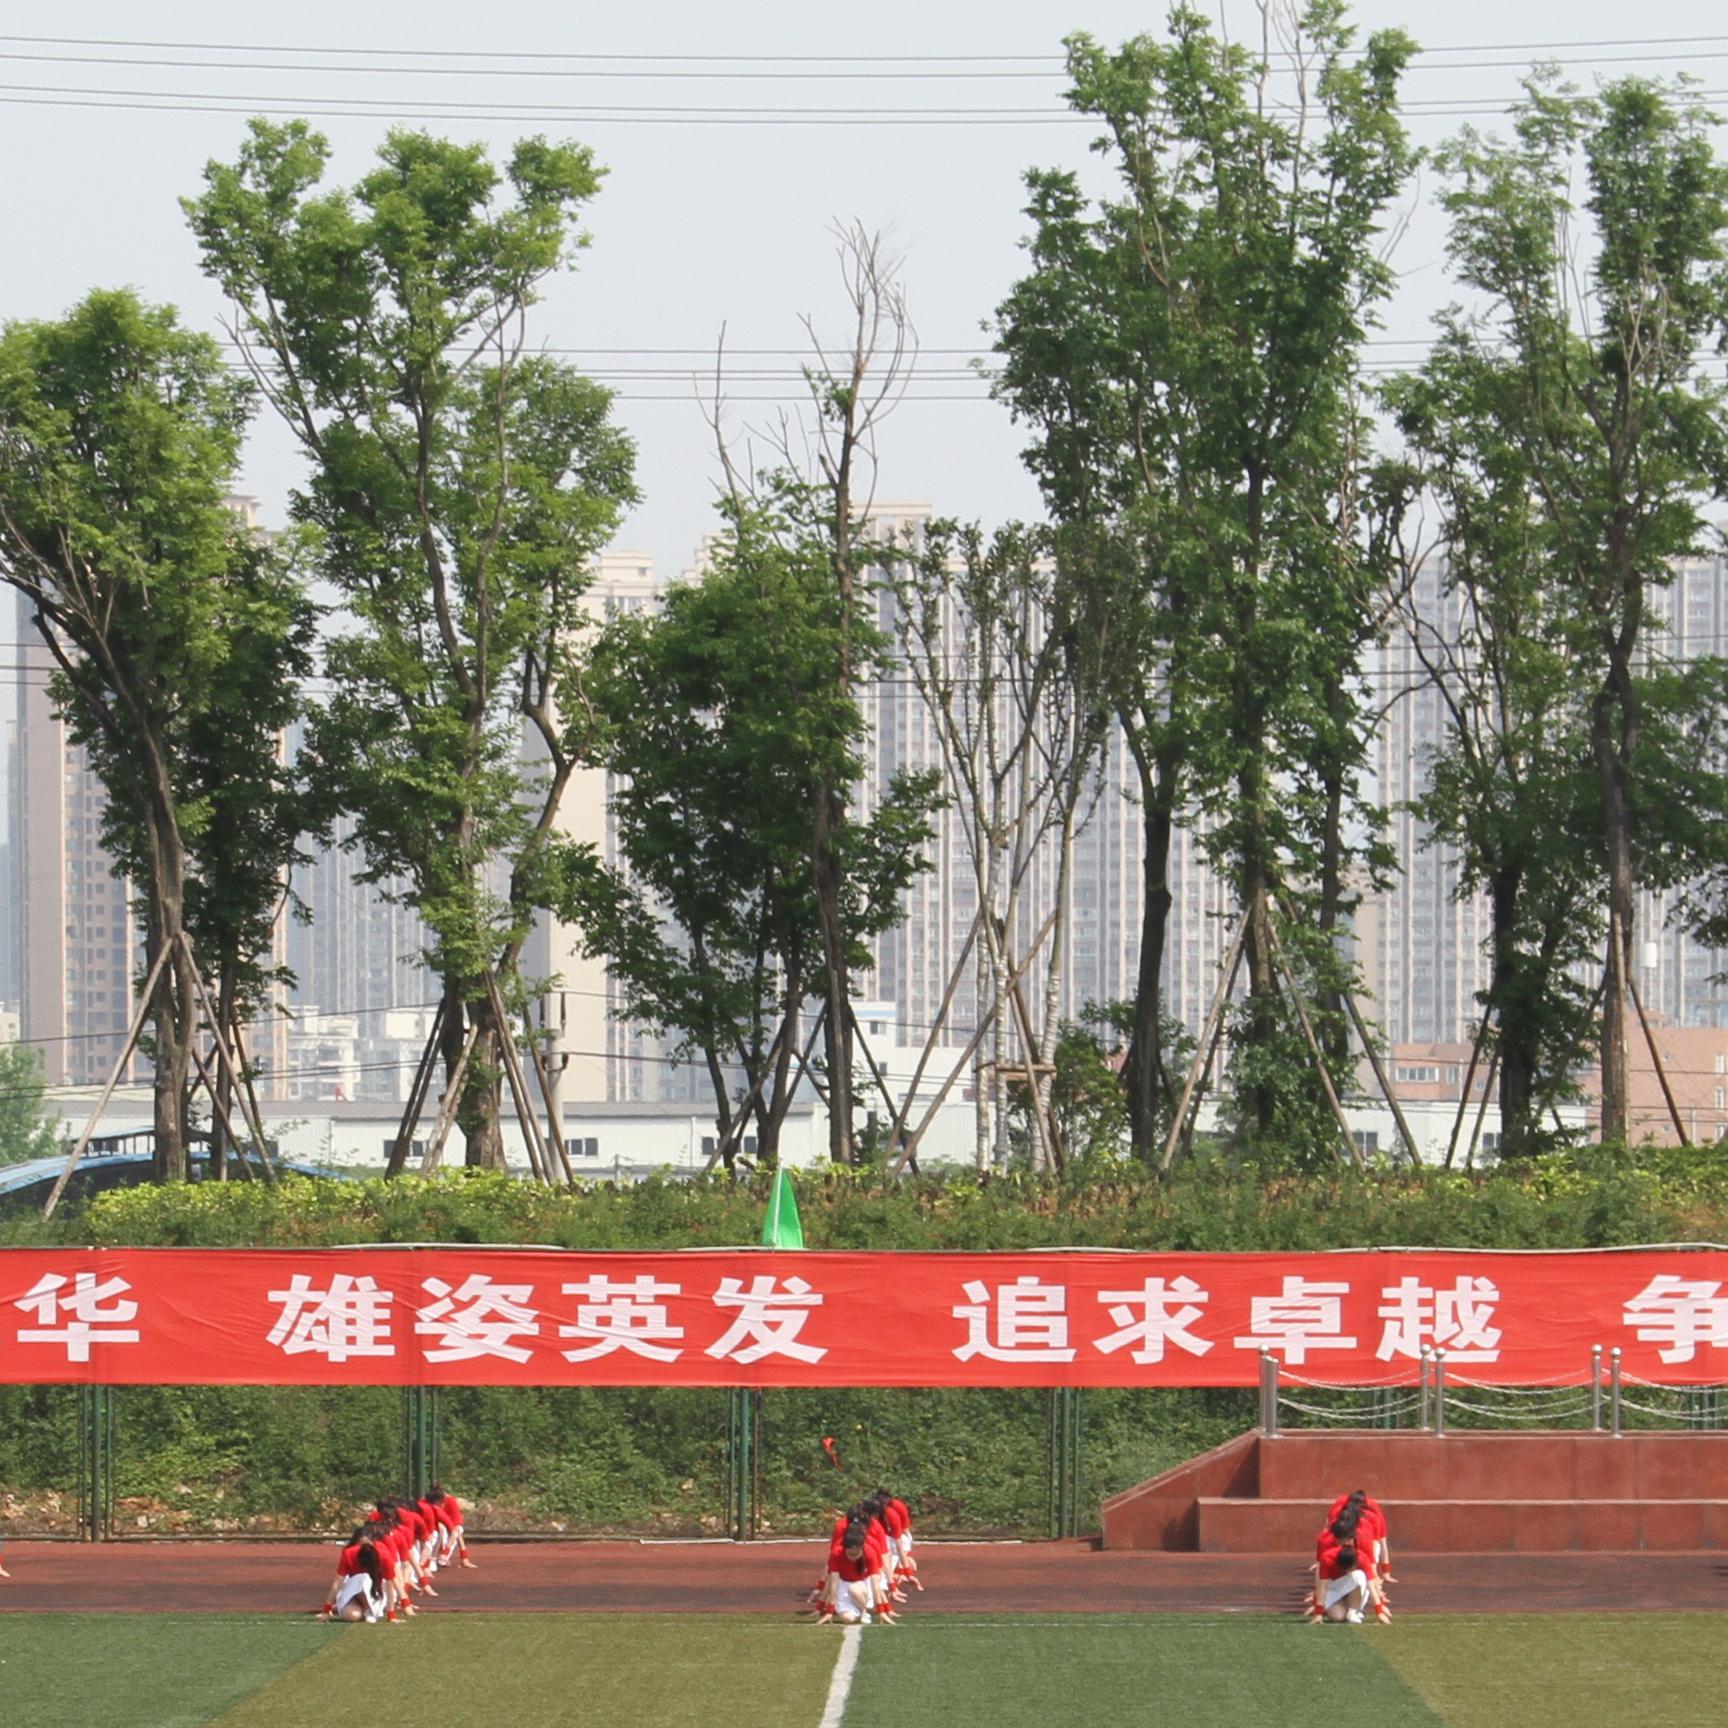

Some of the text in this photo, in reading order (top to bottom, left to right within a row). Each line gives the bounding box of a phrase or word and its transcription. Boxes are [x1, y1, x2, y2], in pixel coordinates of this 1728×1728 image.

[265, 1273, 830, 1365] 雄姿英发
[951, 1274, 1503, 1364] 追求卓越
